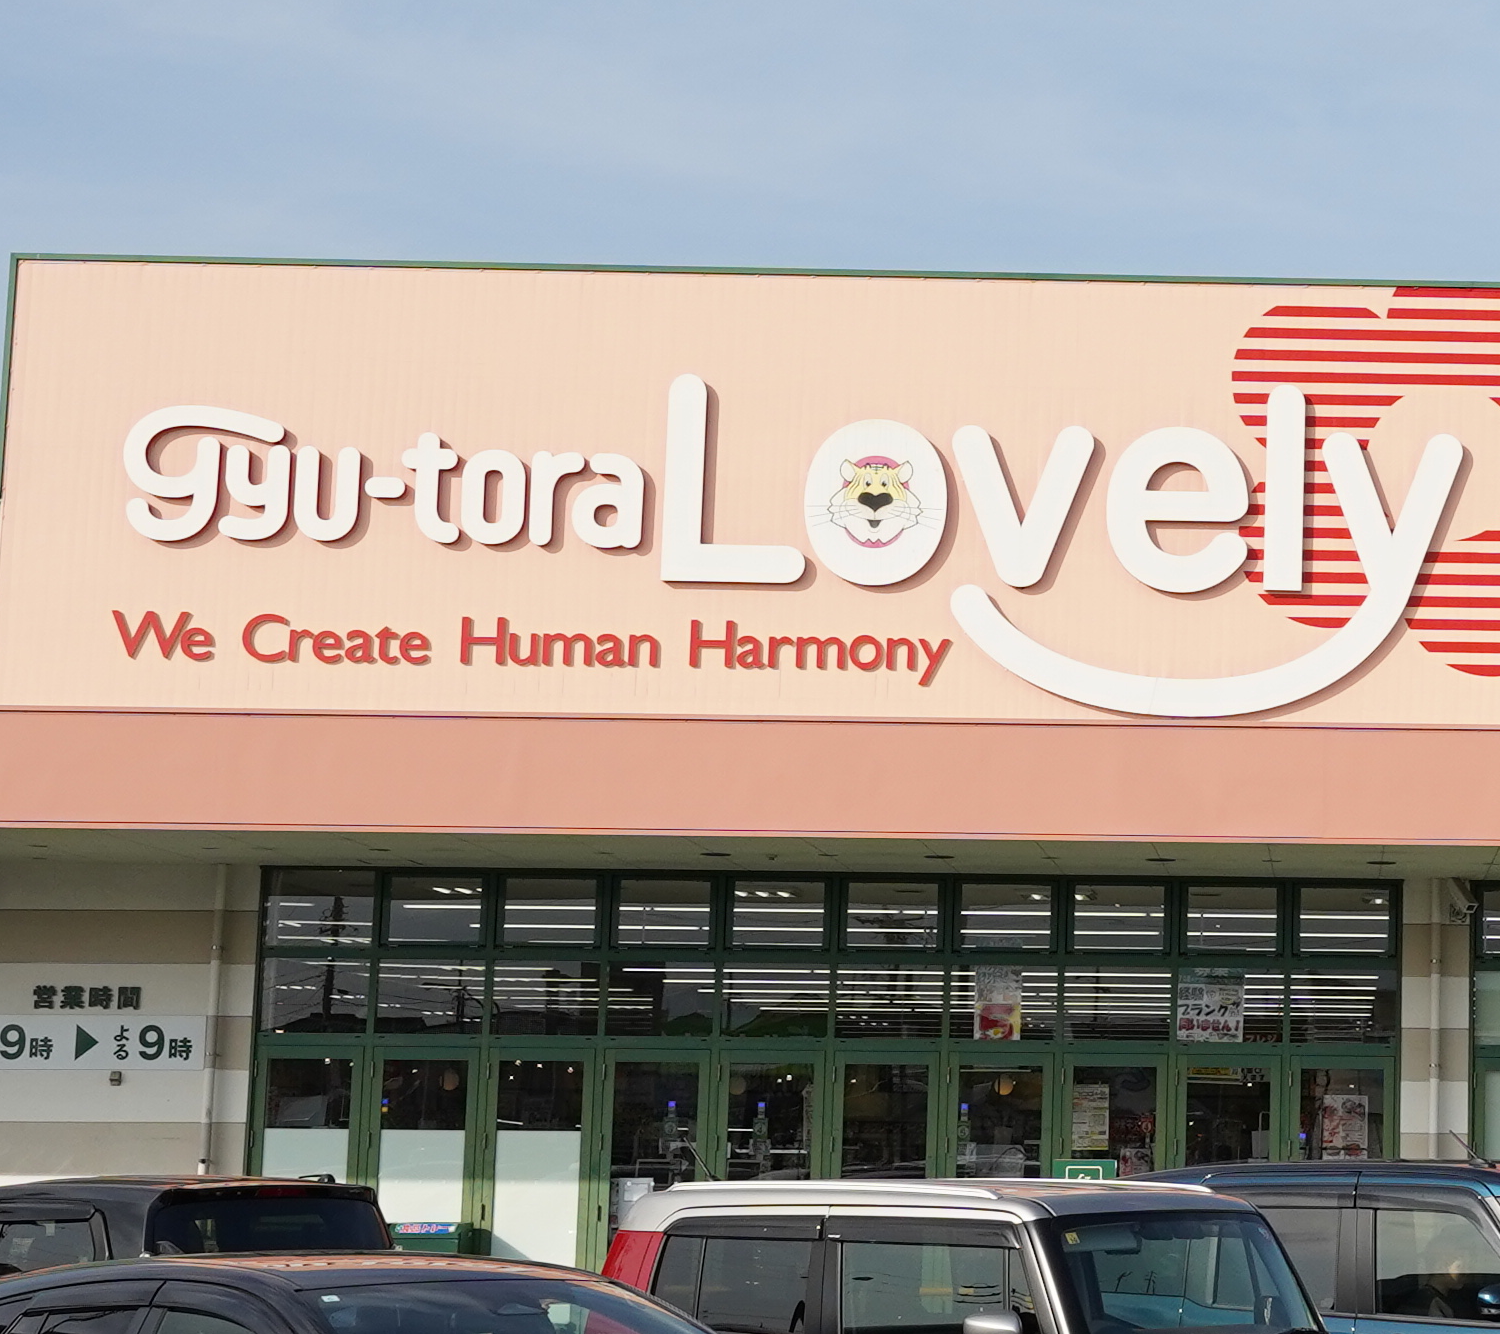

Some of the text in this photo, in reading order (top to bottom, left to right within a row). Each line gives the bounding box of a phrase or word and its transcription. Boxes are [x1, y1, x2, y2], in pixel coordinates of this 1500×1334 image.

[122, 373, 1466, 721] gyu-tora Lovely
[112, 609, 954, 688] We Create Human Harmony
[32, 984, 143, 1011] 営業時間
